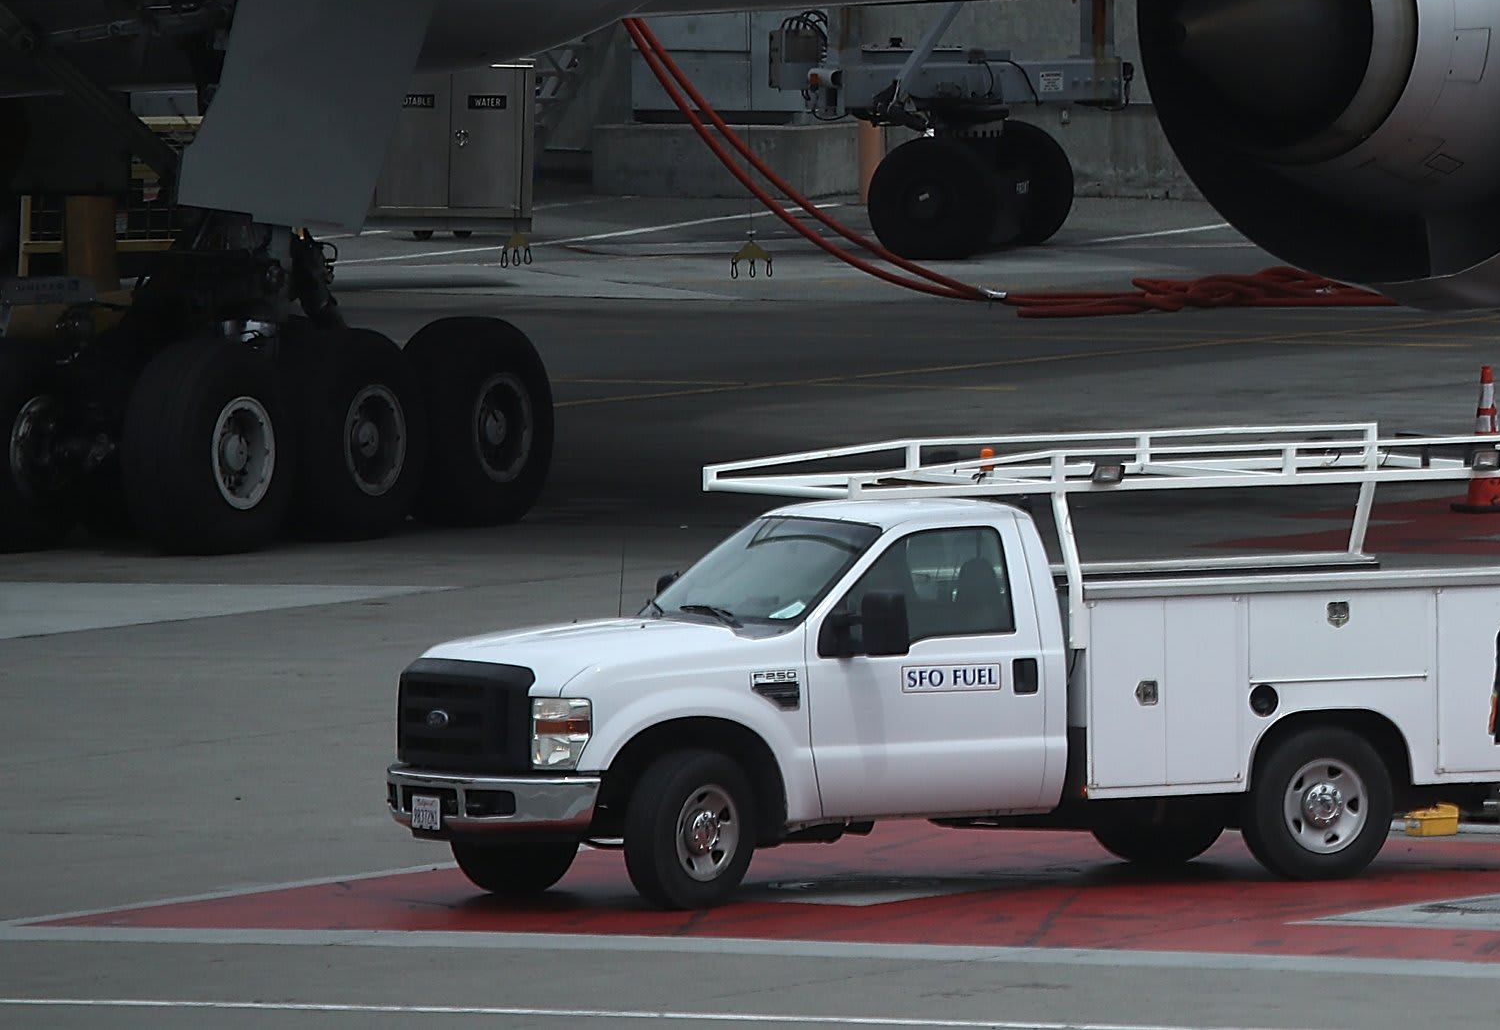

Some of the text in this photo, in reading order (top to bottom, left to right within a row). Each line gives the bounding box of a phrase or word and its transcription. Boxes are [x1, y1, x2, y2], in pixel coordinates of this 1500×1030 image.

[403, 96, 501, 107] OTABLE WATER
[907, 667, 997, 688] SFO FUEL
